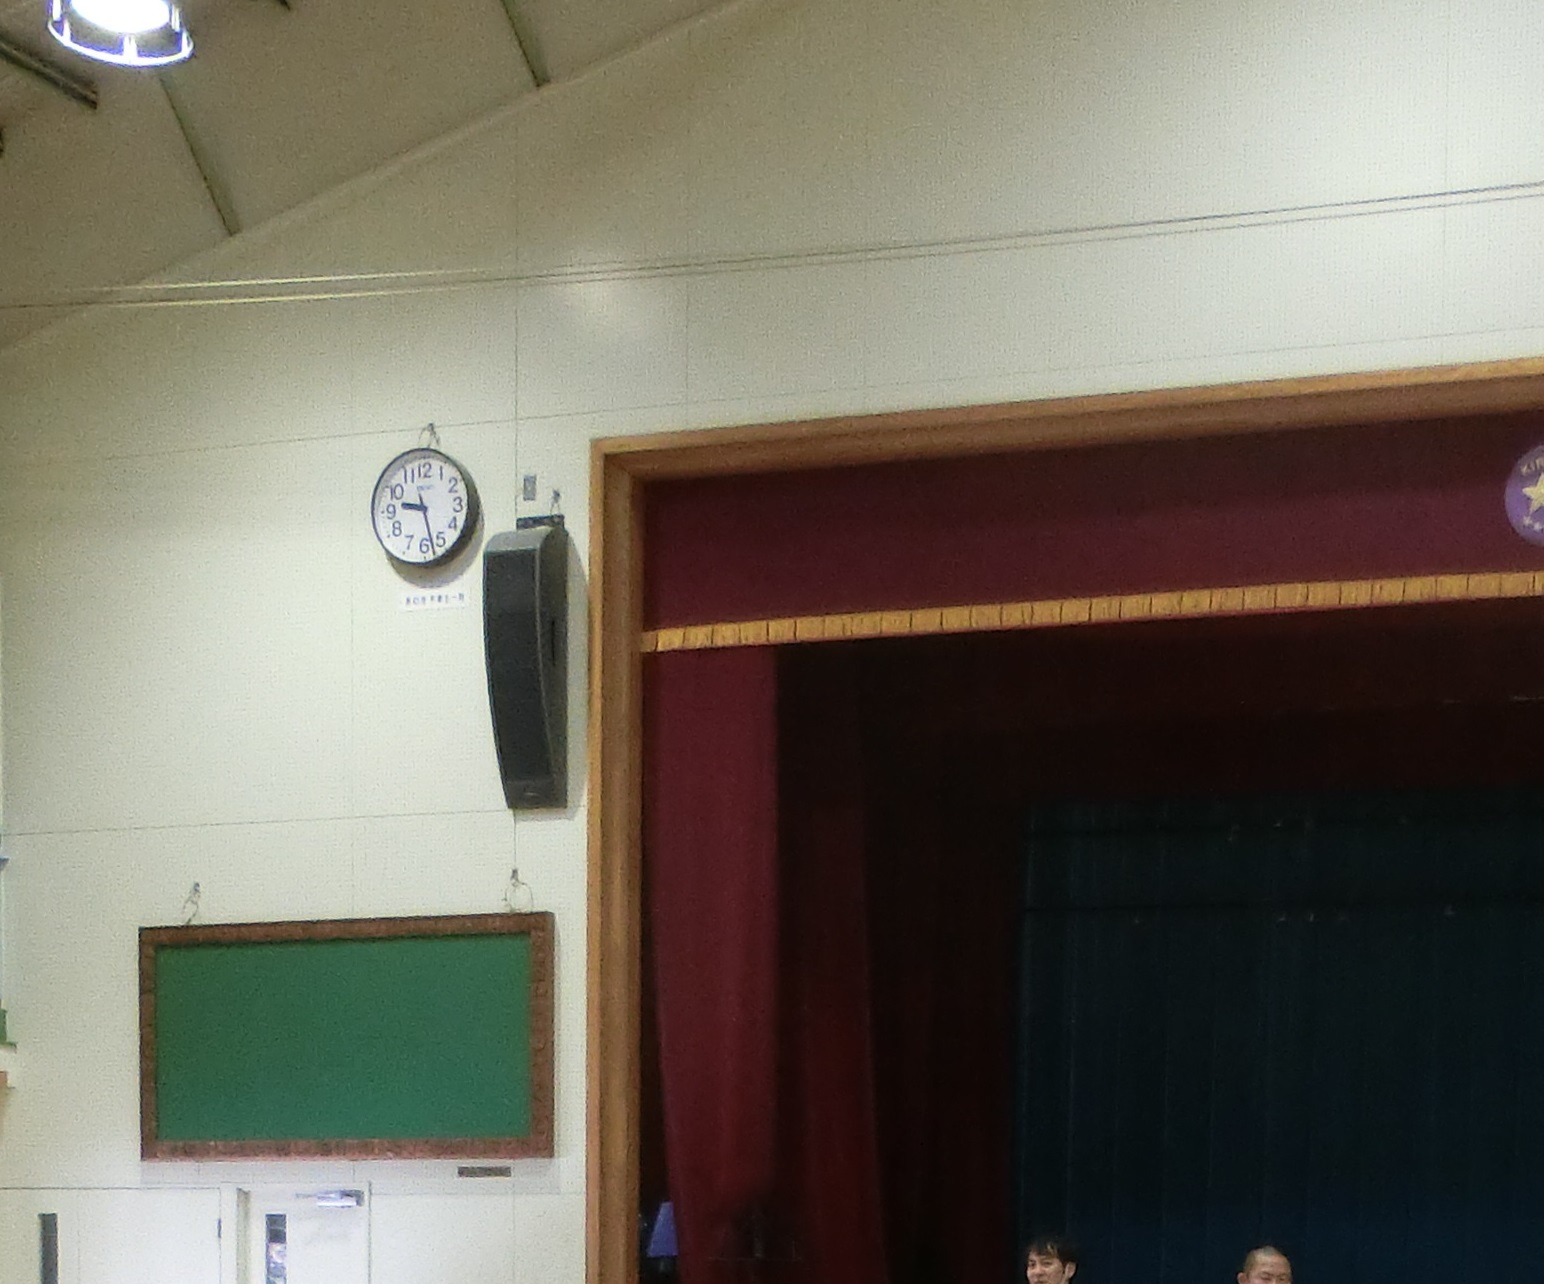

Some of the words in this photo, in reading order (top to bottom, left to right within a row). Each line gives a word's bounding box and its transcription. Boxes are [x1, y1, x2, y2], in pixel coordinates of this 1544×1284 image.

[402, 466, 415, 484] 11
[418, 463, 432, 479] 12
[388, 484, 404, 500] 10
[447, 476, 459, 494] 2
[386, 504, 396, 520] 9
[452, 496, 463, 513] 3
[391, 521, 402, 537] 8
[447, 516, 458, 531] 4
[404, 535, 414, 551] 7
[419, 538, 430, 554] 6
[435, 532, 446, 548] 5
